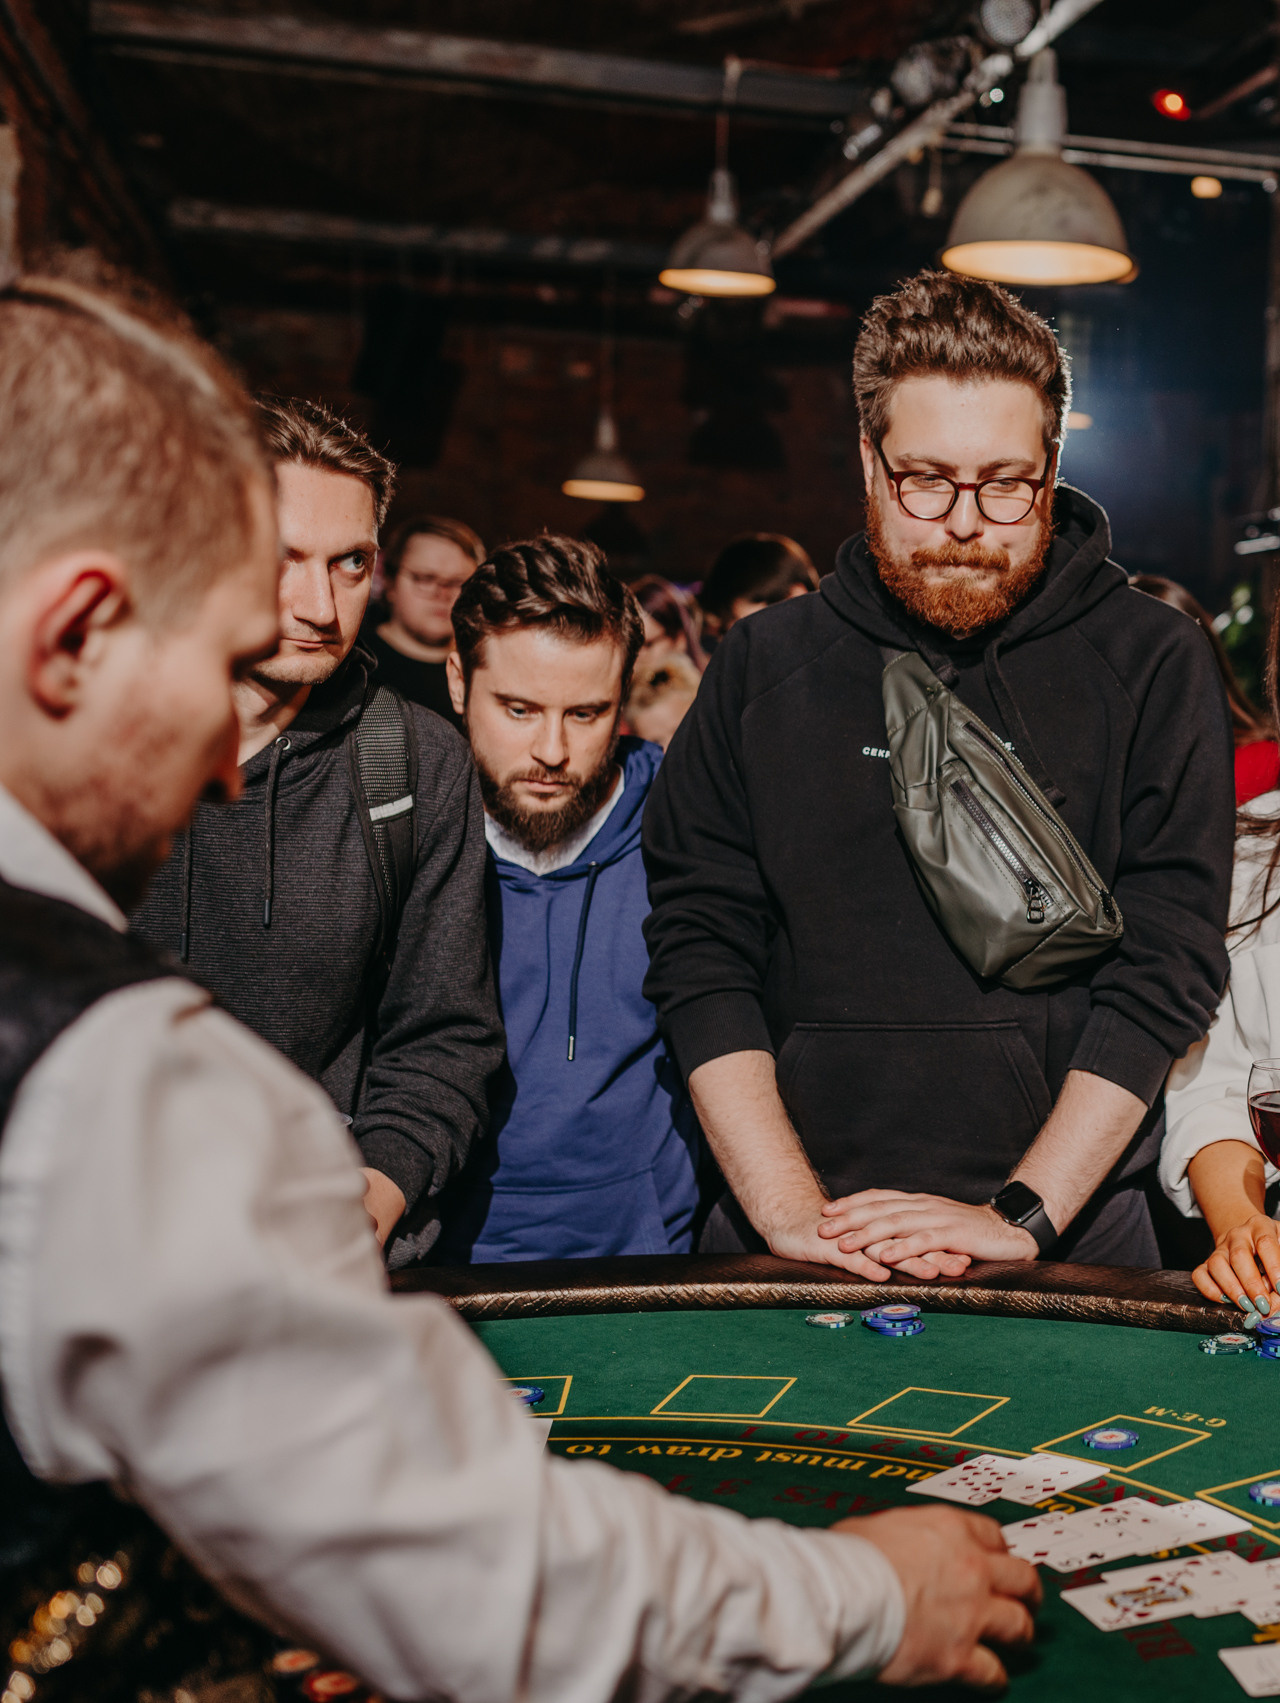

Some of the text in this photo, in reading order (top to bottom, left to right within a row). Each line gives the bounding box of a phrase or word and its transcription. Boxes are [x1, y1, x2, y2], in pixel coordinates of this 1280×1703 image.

[793, 1429, 851, 1446] to
[869, 1437, 907, 1453] 2
[566, 1443, 612, 1457] to
[627, 1443, 743, 1463] draw
[754, 1449, 873, 1472] must
[868, 1464, 936, 1481] nd
[773, 1486, 895, 1515] AYS
